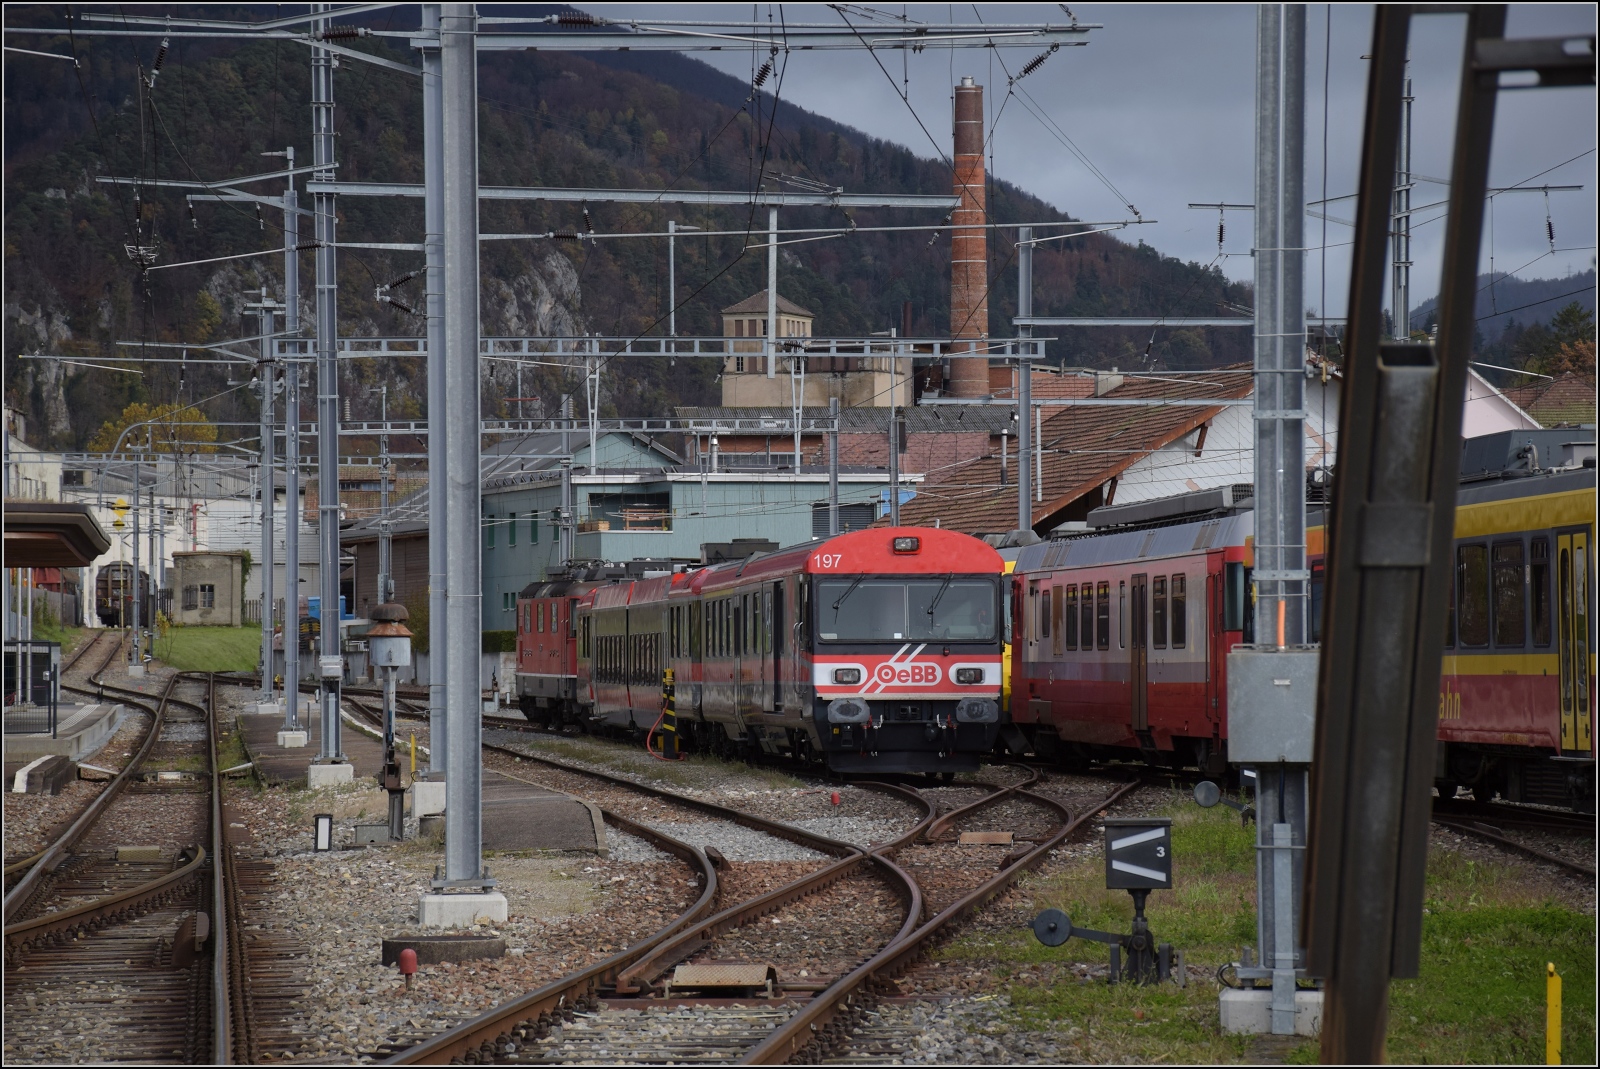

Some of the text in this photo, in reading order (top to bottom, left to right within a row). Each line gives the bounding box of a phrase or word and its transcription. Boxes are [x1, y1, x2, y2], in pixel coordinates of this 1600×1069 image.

[814, 554, 842, 568] 197
[877, 664, 937, 683] OeBB
[1439, 681, 1460, 719] ahn
[1156, 846, 1165, 858] 3
